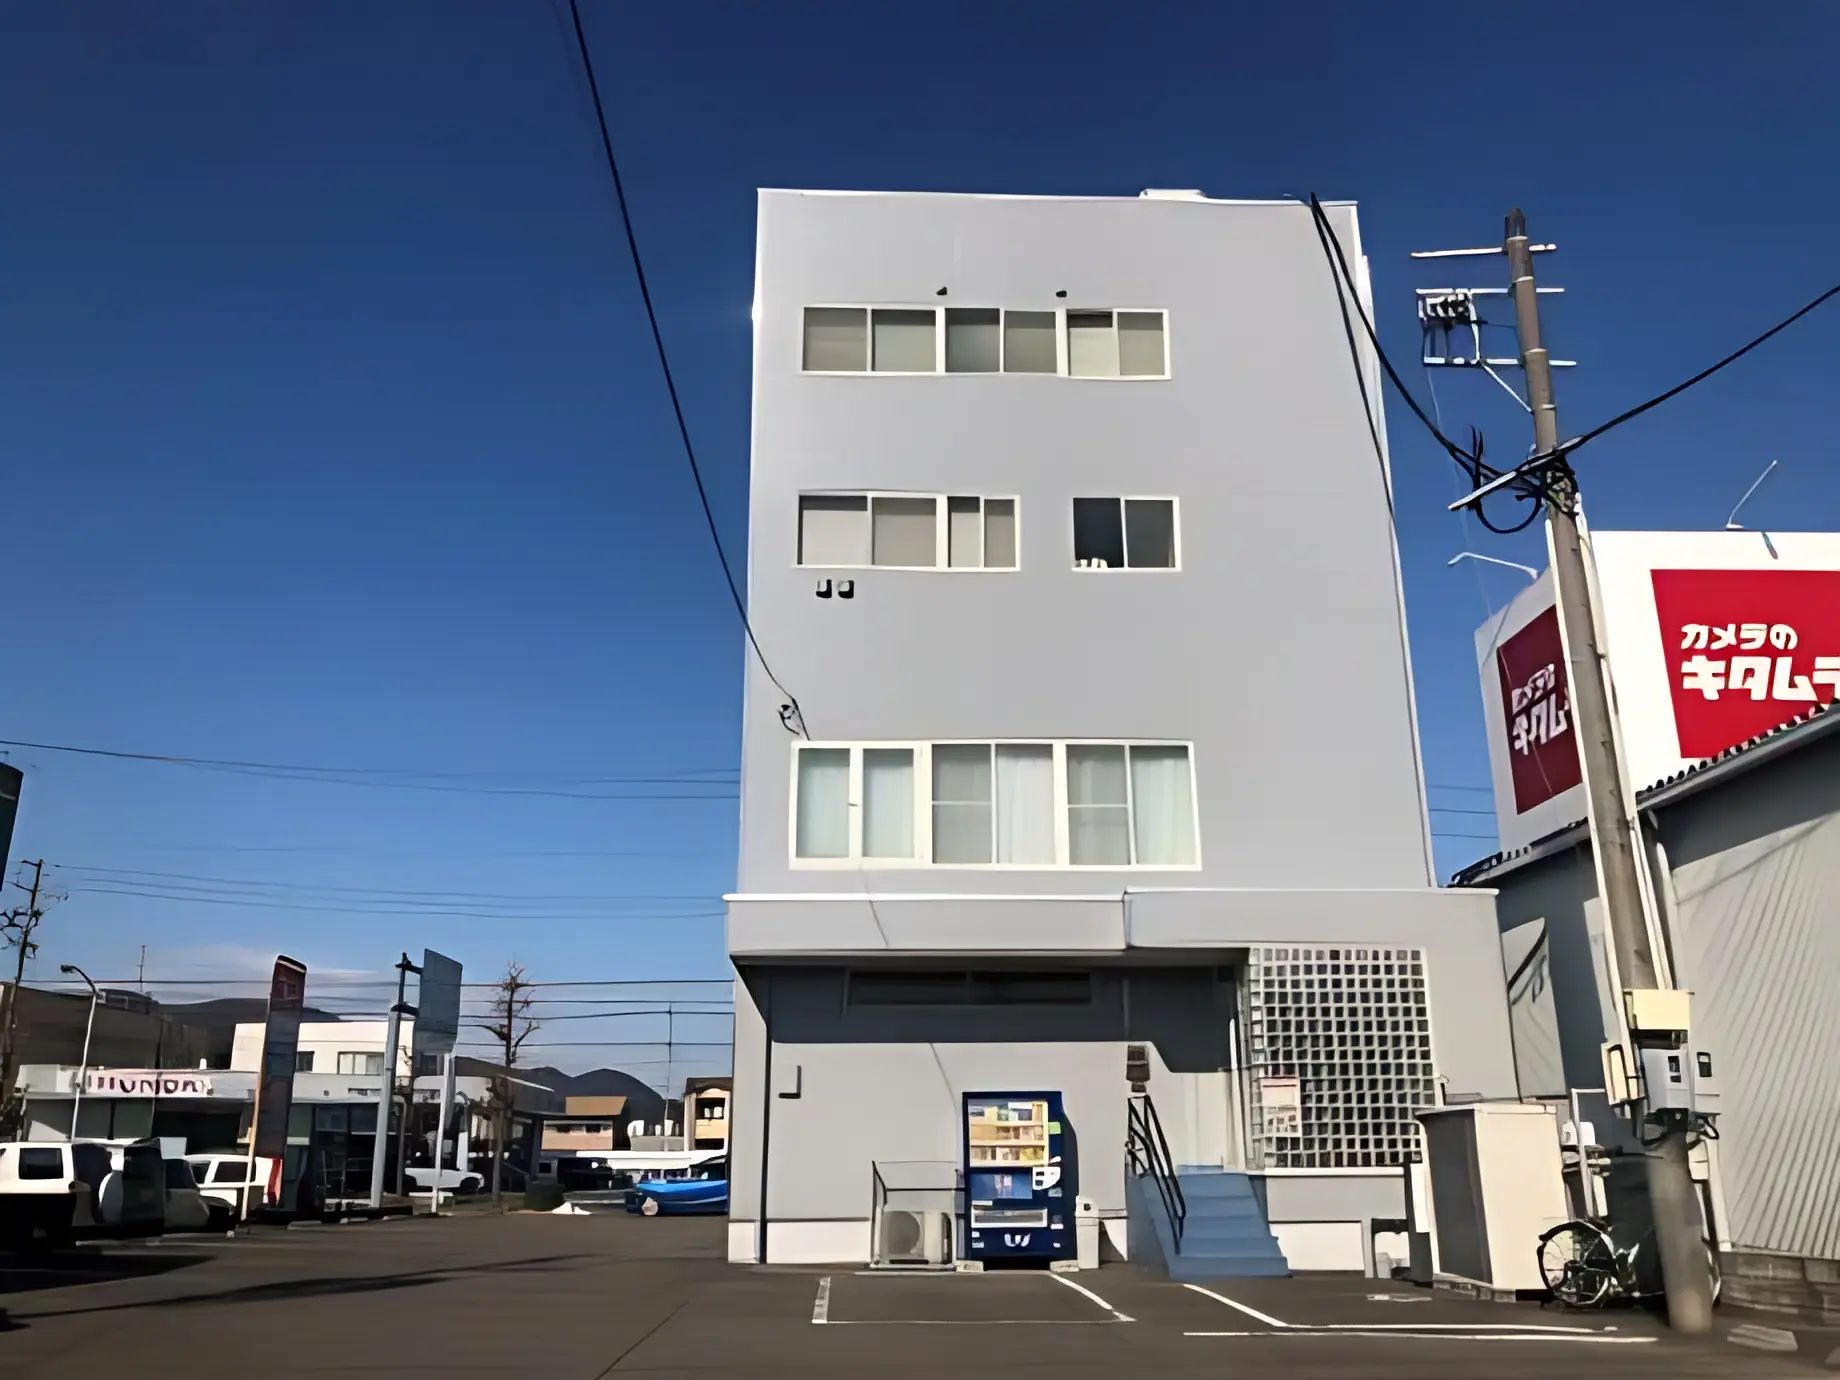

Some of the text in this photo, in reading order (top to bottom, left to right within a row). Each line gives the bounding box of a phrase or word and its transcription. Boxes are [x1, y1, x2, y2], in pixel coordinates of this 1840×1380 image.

[1681, 623, 1798, 650] カメラの
[1512, 687, 1569, 755] キタム
